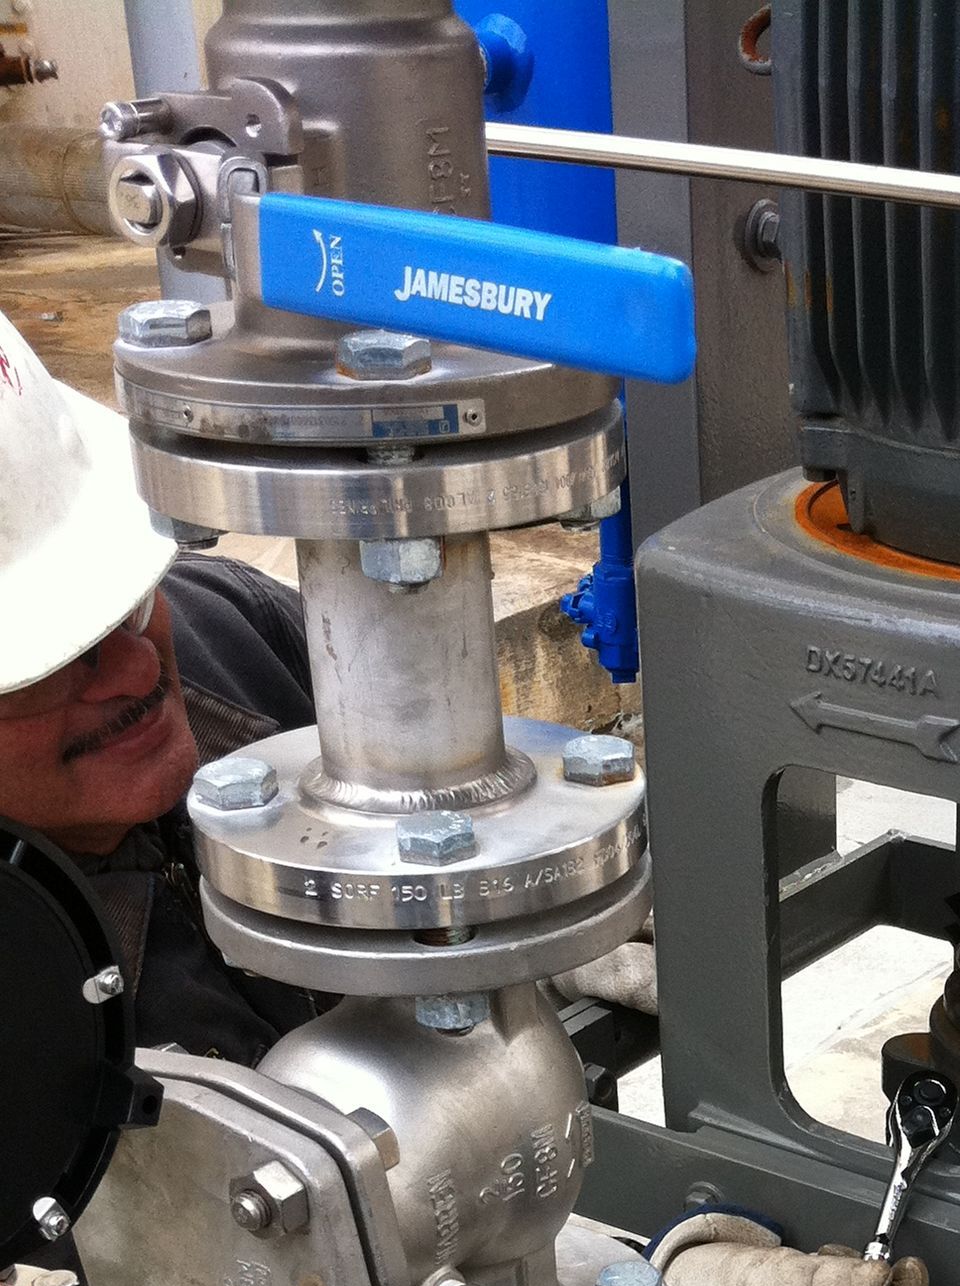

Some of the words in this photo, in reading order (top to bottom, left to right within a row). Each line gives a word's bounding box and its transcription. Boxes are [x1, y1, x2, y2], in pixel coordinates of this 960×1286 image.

[329, 234, 345, 297] OPEN
[394, 265, 552, 321] JAMESBURY
[805, 644, 940, 699] DX57441A
[304, 880, 318, 898] 2
[390, 885, 428, 901] 150
[440, 884, 465, 900] LB
